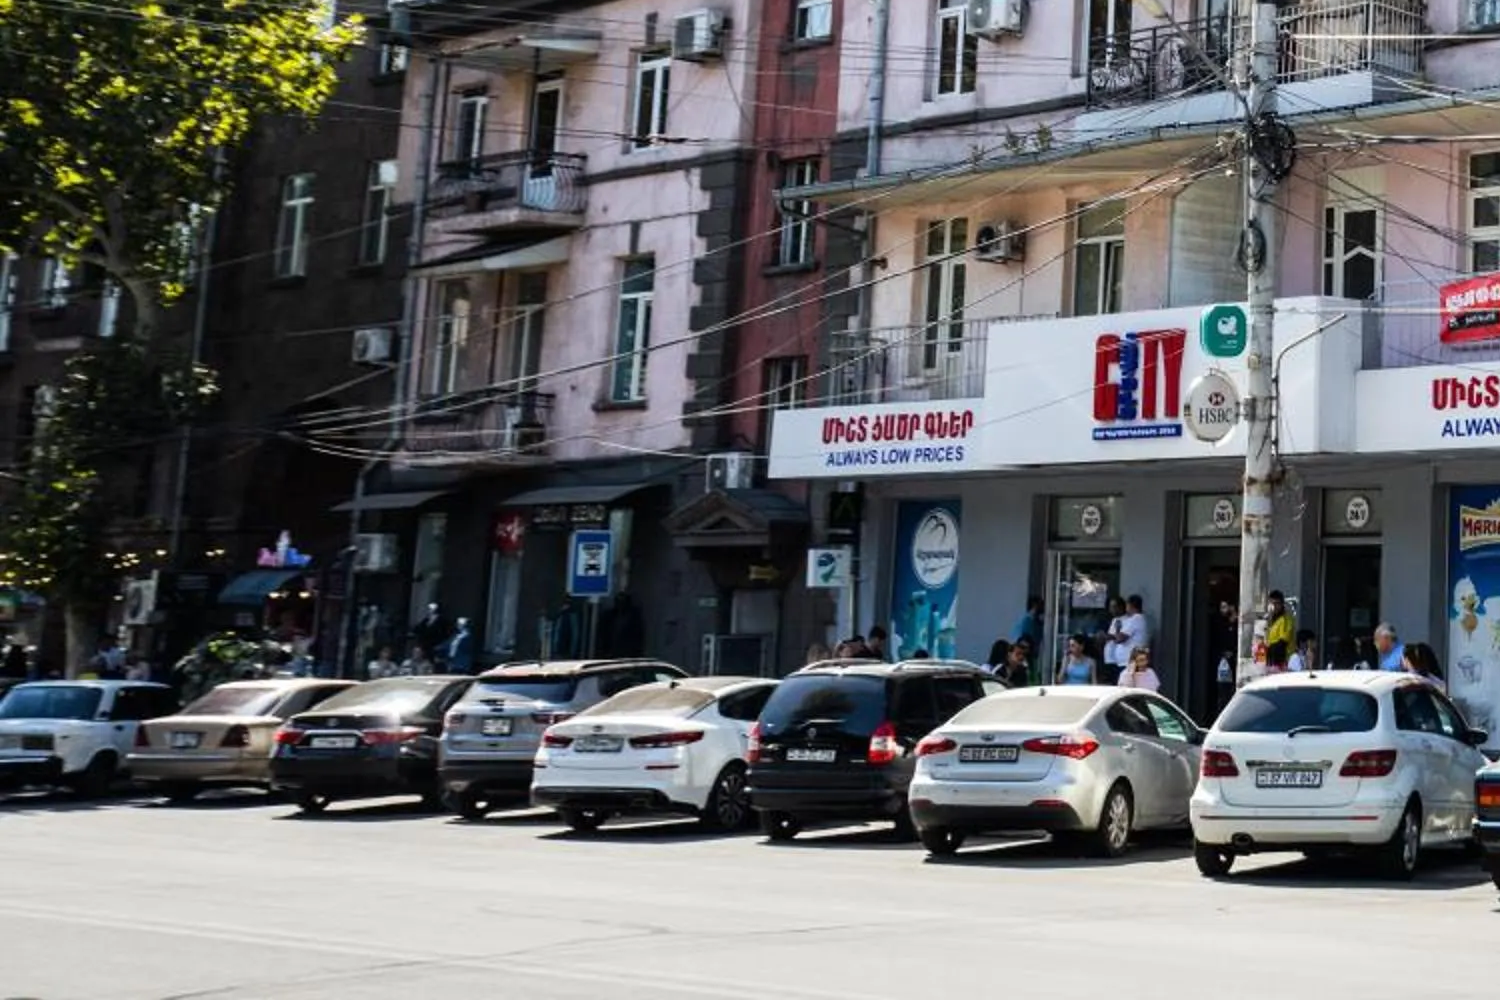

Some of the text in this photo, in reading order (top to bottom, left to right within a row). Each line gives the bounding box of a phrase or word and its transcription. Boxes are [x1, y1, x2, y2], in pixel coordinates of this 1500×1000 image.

[1432, 375, 1500, 411] ՄԻՇՏ
[821, 409, 974, 444] ՄԻՇՏ ՑԱԾՐ ԳՆԵՐ
[1198, 406, 1234, 425] HSBC
[826, 445, 964, 467] ALWAYS LOW PRICES
